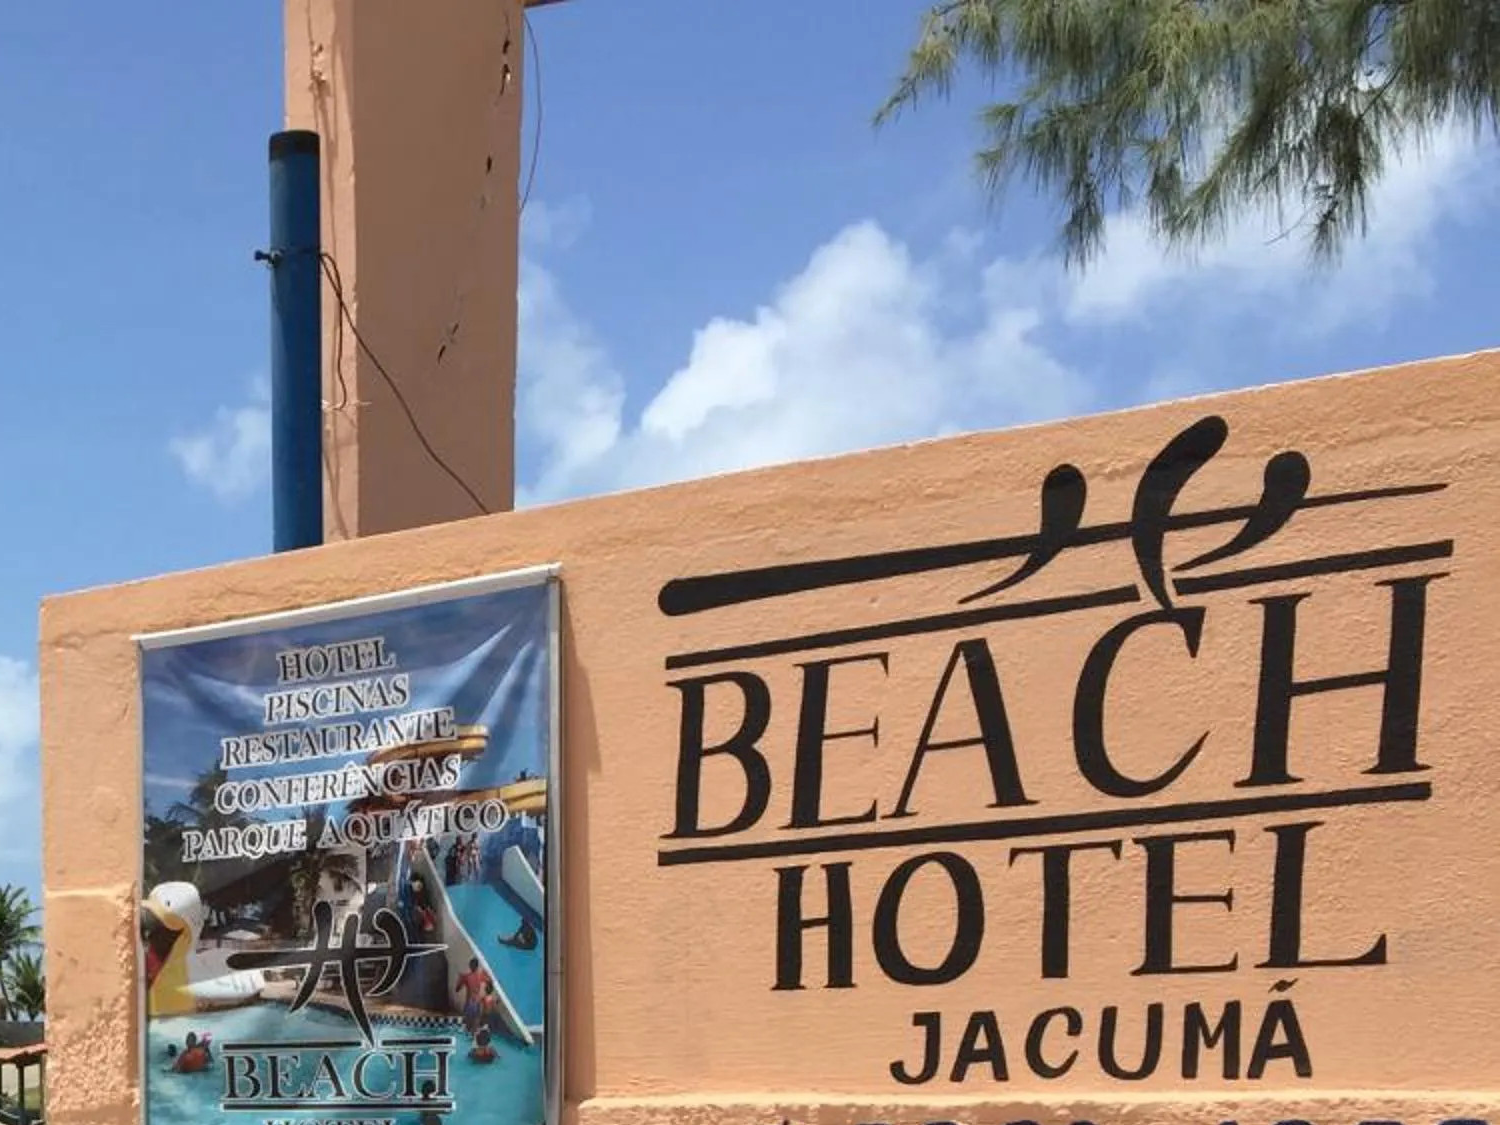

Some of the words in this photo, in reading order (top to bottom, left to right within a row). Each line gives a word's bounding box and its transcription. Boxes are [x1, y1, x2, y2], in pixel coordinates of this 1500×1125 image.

[277, 638, 396, 683] HOTEL
[264, 674, 409, 725] PISCINAS
[663, 572, 1451, 839] BEACH
[221, 708, 458, 769] RESTAURANTE
[214, 754, 462, 815] CONFERÊNCIAS
[182, 820, 307, 862] PARQUE
[317, 800, 510, 849] AQUÁTICO
[771, 822, 1387, 991] HOTEL
[890, 979, 1313, 1085] JACUMÁ
[222, 1049, 455, 1101] BEACH
